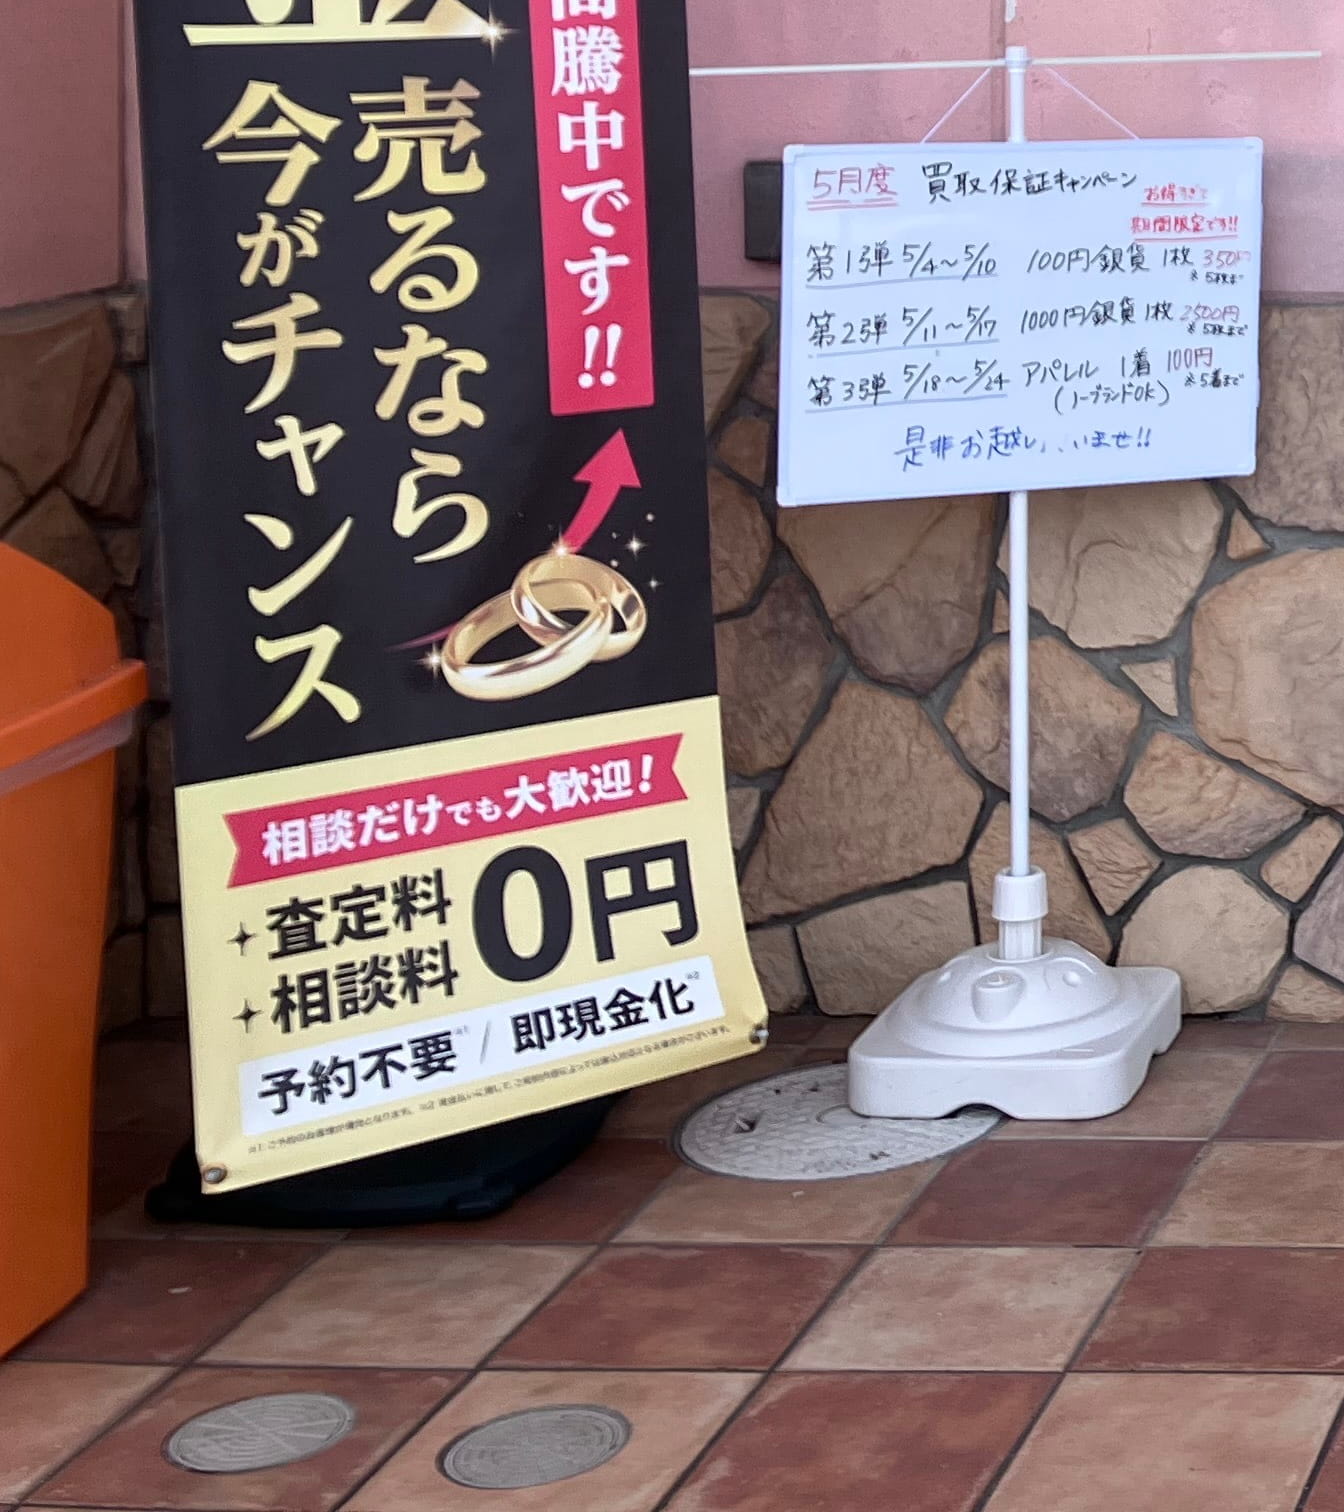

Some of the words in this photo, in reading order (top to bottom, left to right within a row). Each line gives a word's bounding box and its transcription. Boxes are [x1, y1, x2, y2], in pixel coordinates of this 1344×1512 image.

[812, 162, 898, 200] 5月度
[920, 160, 1138, 204] 買取保証キャンペーン
[806, 239, 894, 283] 第1弾
[349, 76, 490, 564] 売るなら
[806, 309, 888, 349] 第2弾
[202, 80, 362, 743] 今がチャンス
[806, 371, 892, 407] 第3弾
[1022, 358, 1099, 387] アパレル
[1167, 346, 1214, 374] 100円
[261, 755, 655, 867] 相談だけでも大歓迎!
[266, 868, 453, 959] 査定料
[472, 839, 701, 983] 0円
[271, 941, 459, 1034] 相談料
[257, 1029, 458, 1116] 予約不要
[511, 978, 695, 1054] 即現金化
